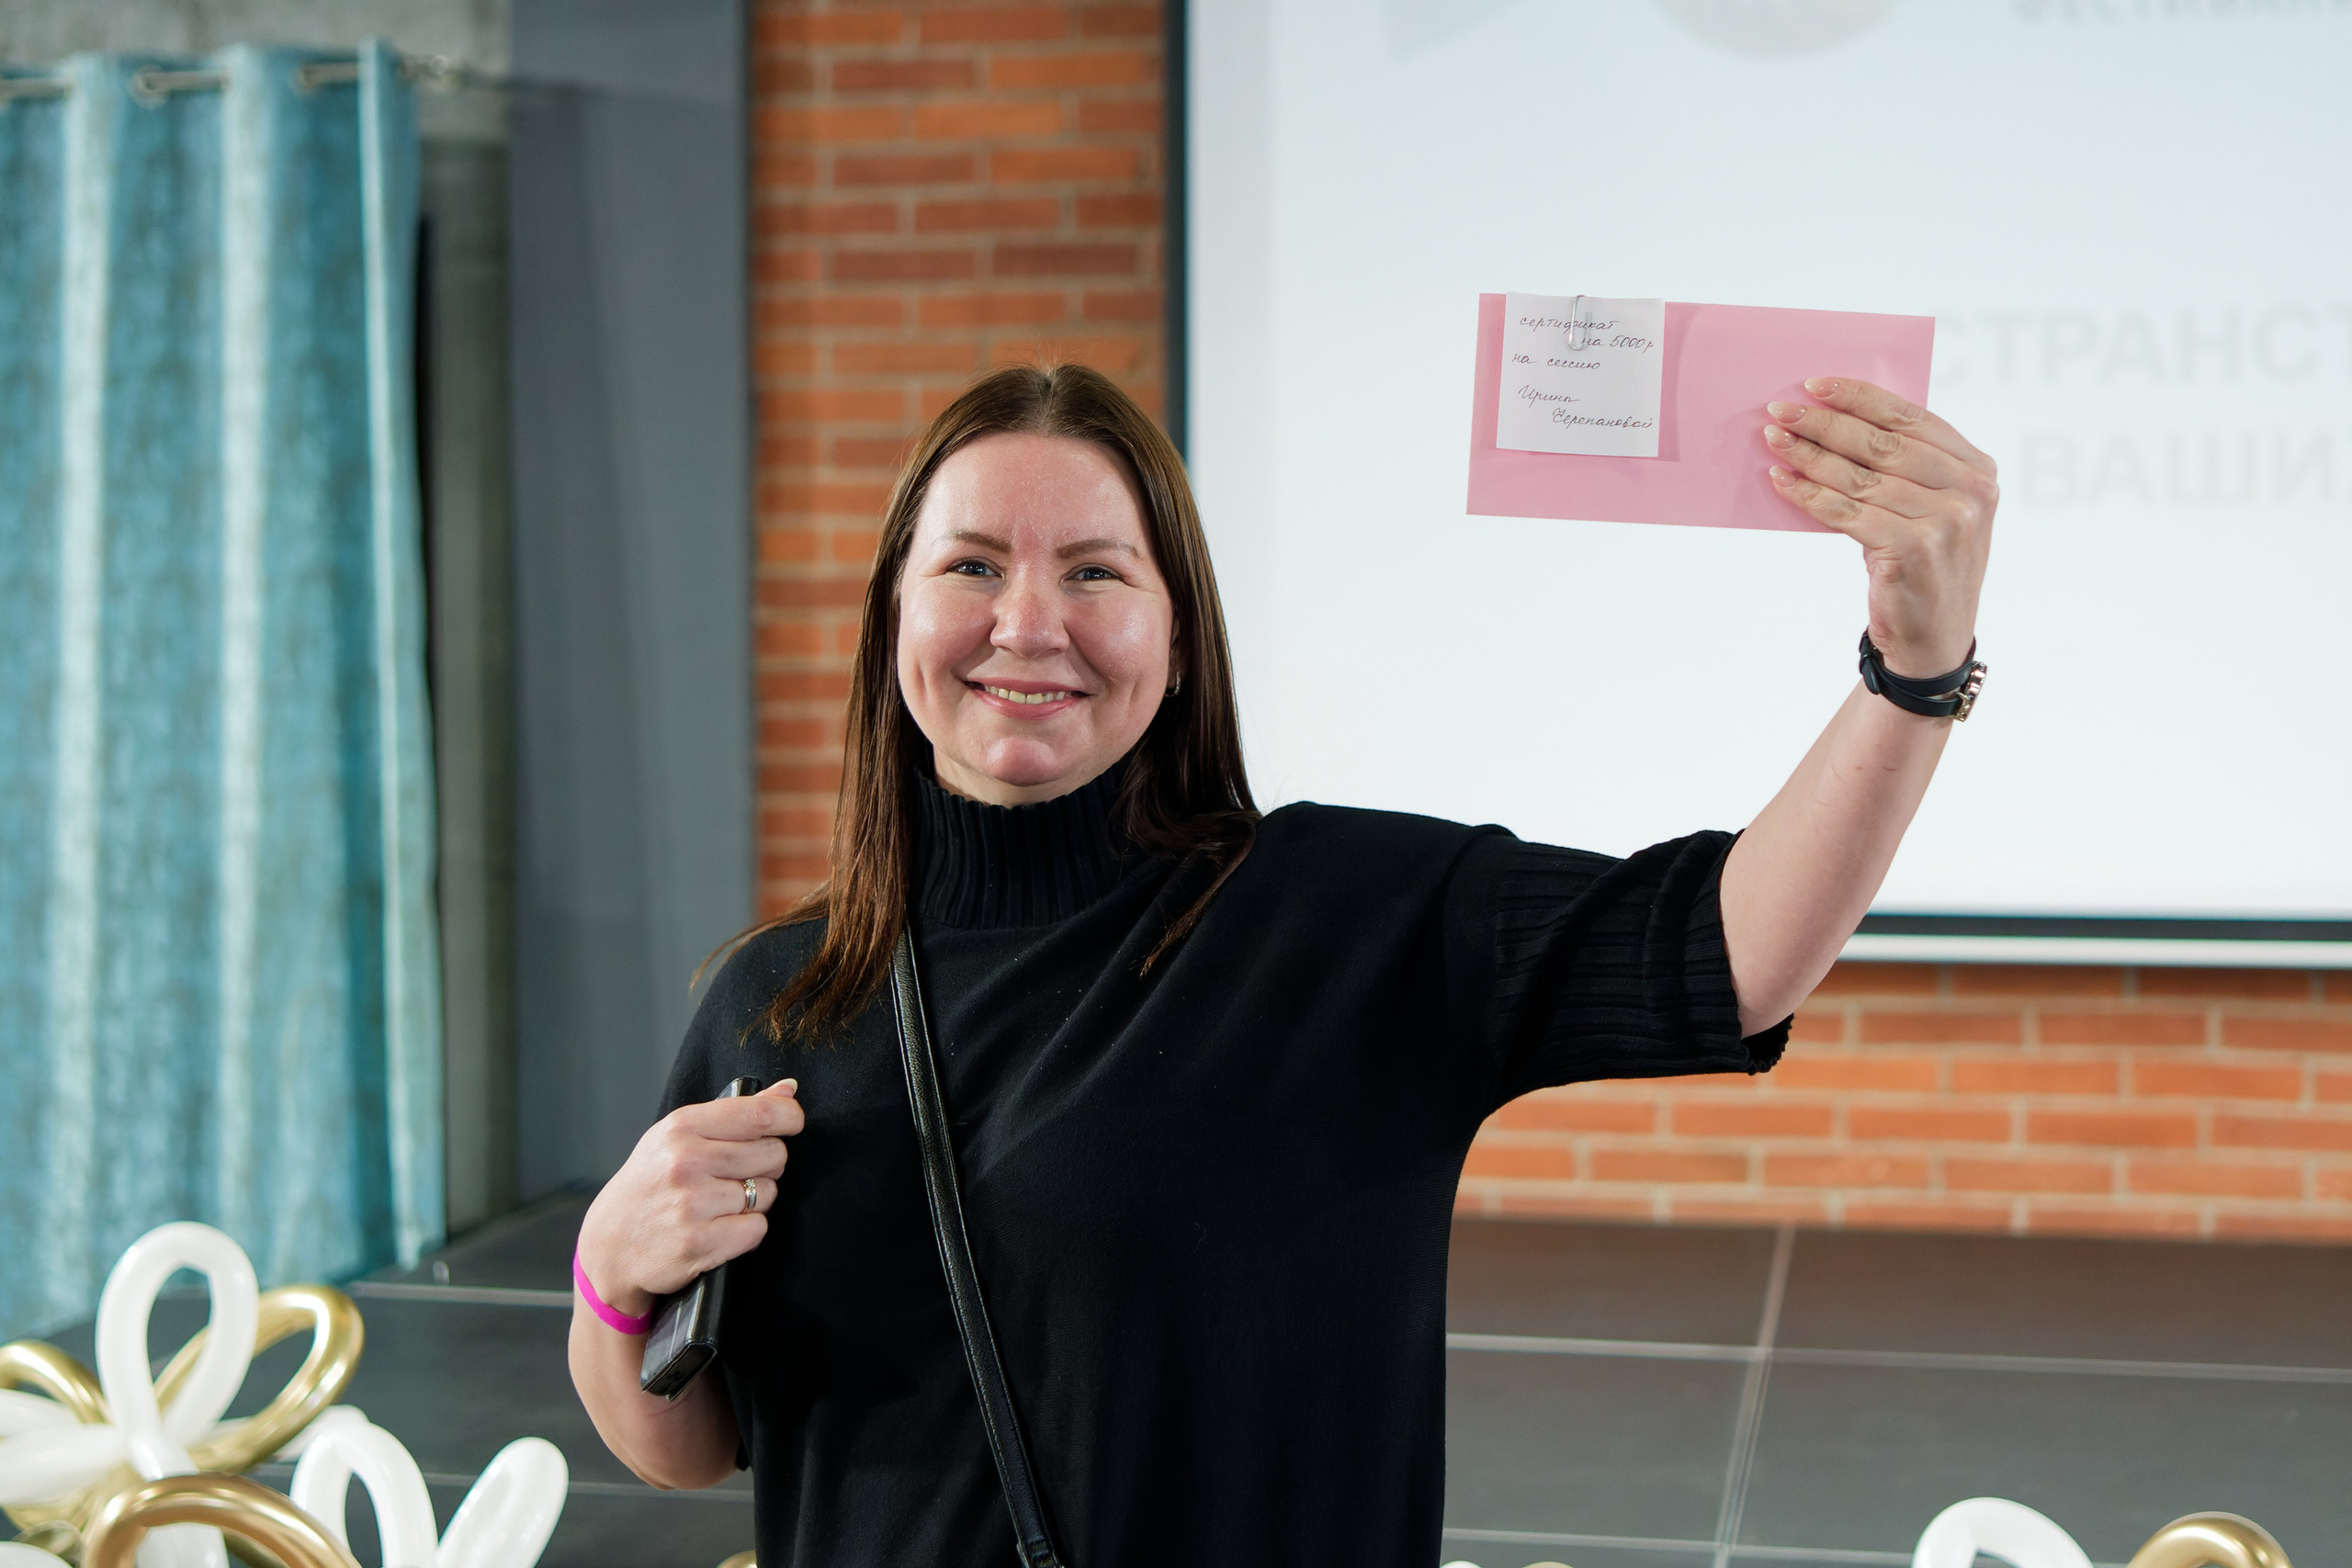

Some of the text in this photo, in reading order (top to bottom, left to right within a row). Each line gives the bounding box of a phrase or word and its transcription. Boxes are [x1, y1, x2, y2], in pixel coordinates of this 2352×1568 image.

[1519, 317, 1621, 335] сертификат
[1580, 336, 1604, 346] на
[1511, 352, 1601, 370] на сессию
[2017, 429, 2352, 505] ВАШИ
